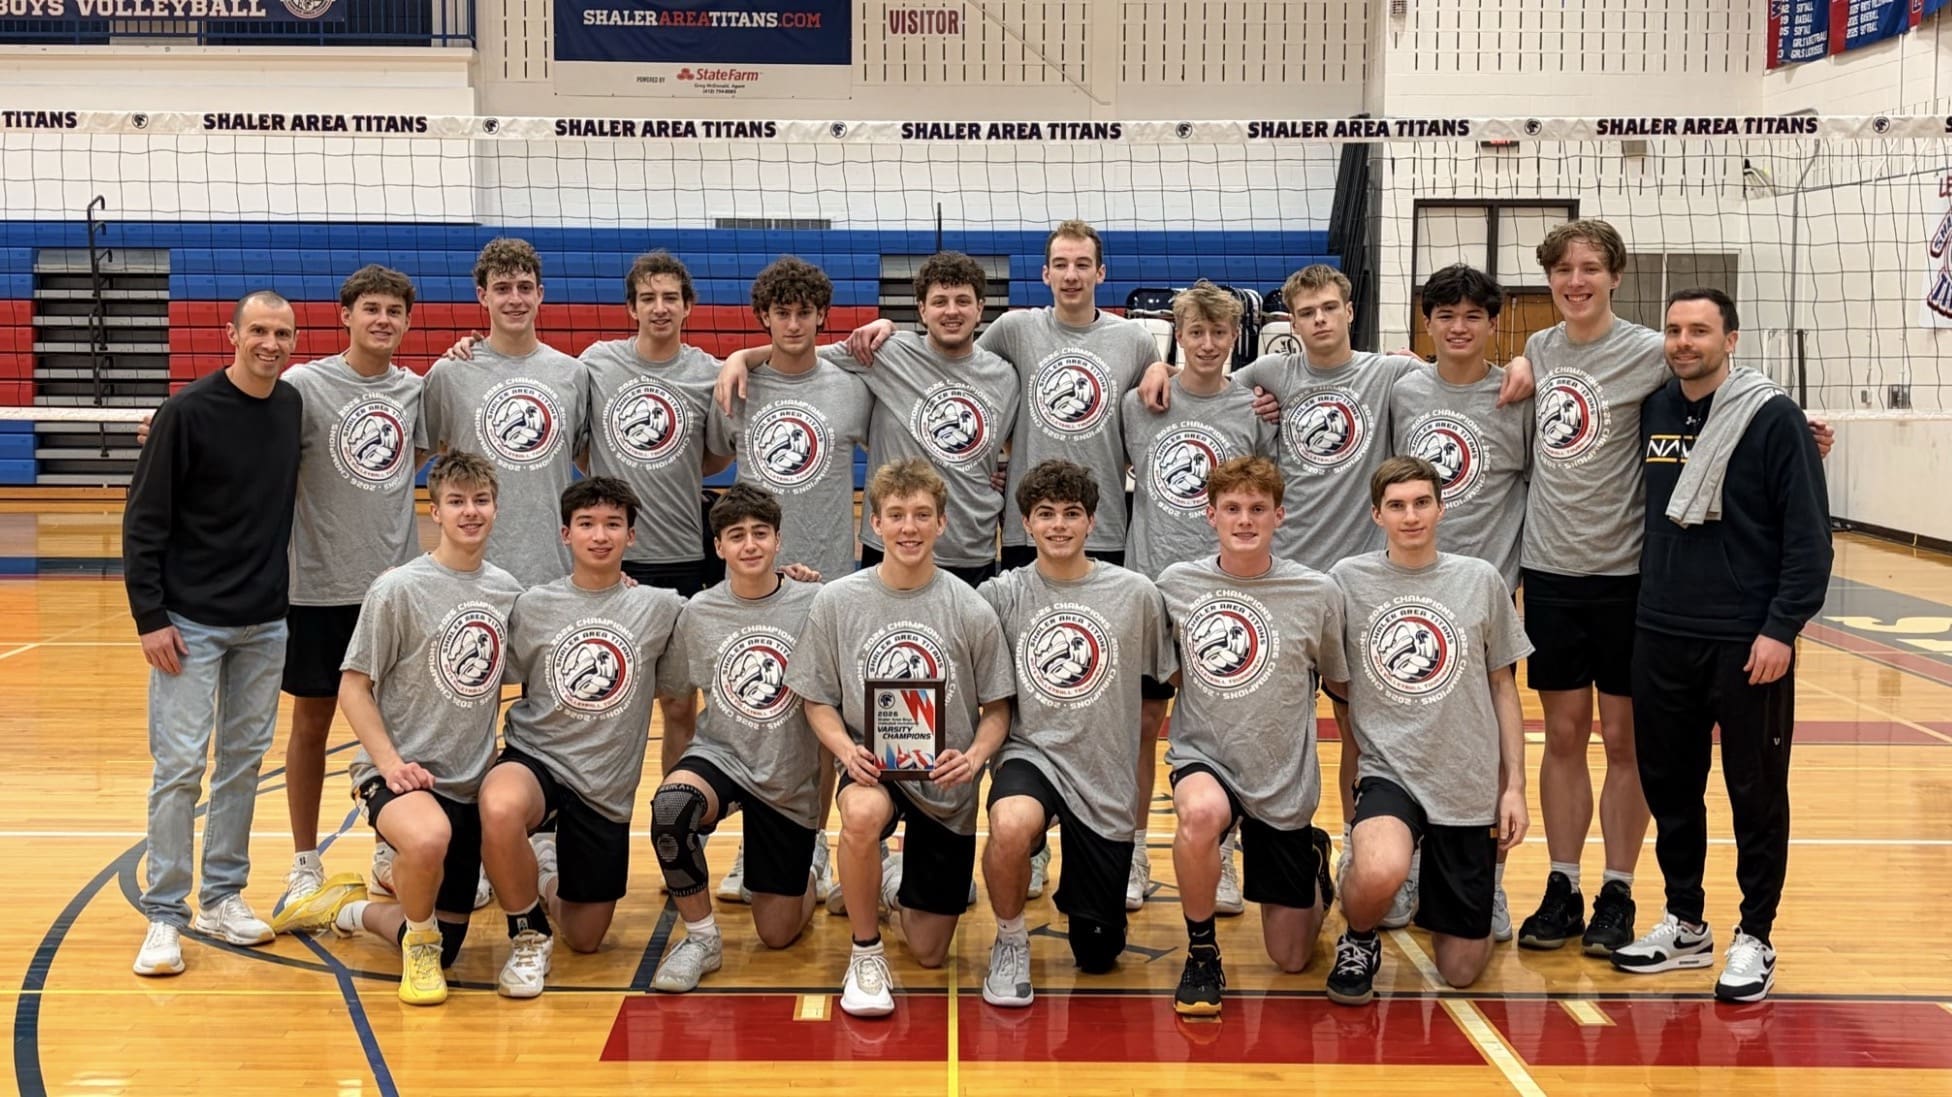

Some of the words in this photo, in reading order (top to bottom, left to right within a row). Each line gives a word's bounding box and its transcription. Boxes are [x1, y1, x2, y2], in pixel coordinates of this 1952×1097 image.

[78, 0, 266, 17] VOLLEYBALL
[583, 9, 822, 28] SHALERAREATITANS.COM
[889, 9, 960, 35] VISITOR
[5, 112, 77, 129] TITANS
[204, 113, 285, 130] SHALER
[291, 114, 347, 131] AREA
[353, 115, 428, 132] TITANS
[556, 119, 635, 136] SHALER
[642, 120, 697, 137] AREA
[702, 120, 775, 137] TITANS
[1248, 121, 1328, 138] SHALER
[1334, 120, 1389, 137] AREA
[1396, 119, 1469, 136] TITANS
[1597, 118, 1676, 136] SHALER
[1683, 118, 1738, 135] AREA
[1745, 117, 1818, 134] TITANS
[902, 122, 980, 139] SHALER
[987, 122, 1042, 139] AREA
[1048, 122, 1121, 139] TITANS
[1216, 590, 1273, 621] CHAMPIONS
[1394, 595, 1456, 619] CHAMPIONS
[1220, 604, 1244, 613] AREA
[1248, 613, 1266, 644] TITANS
[1372, 614, 1396, 644] SHALER
[1431, 615, 1453, 644] TITANS
[870, 638, 891, 673] SHALER
